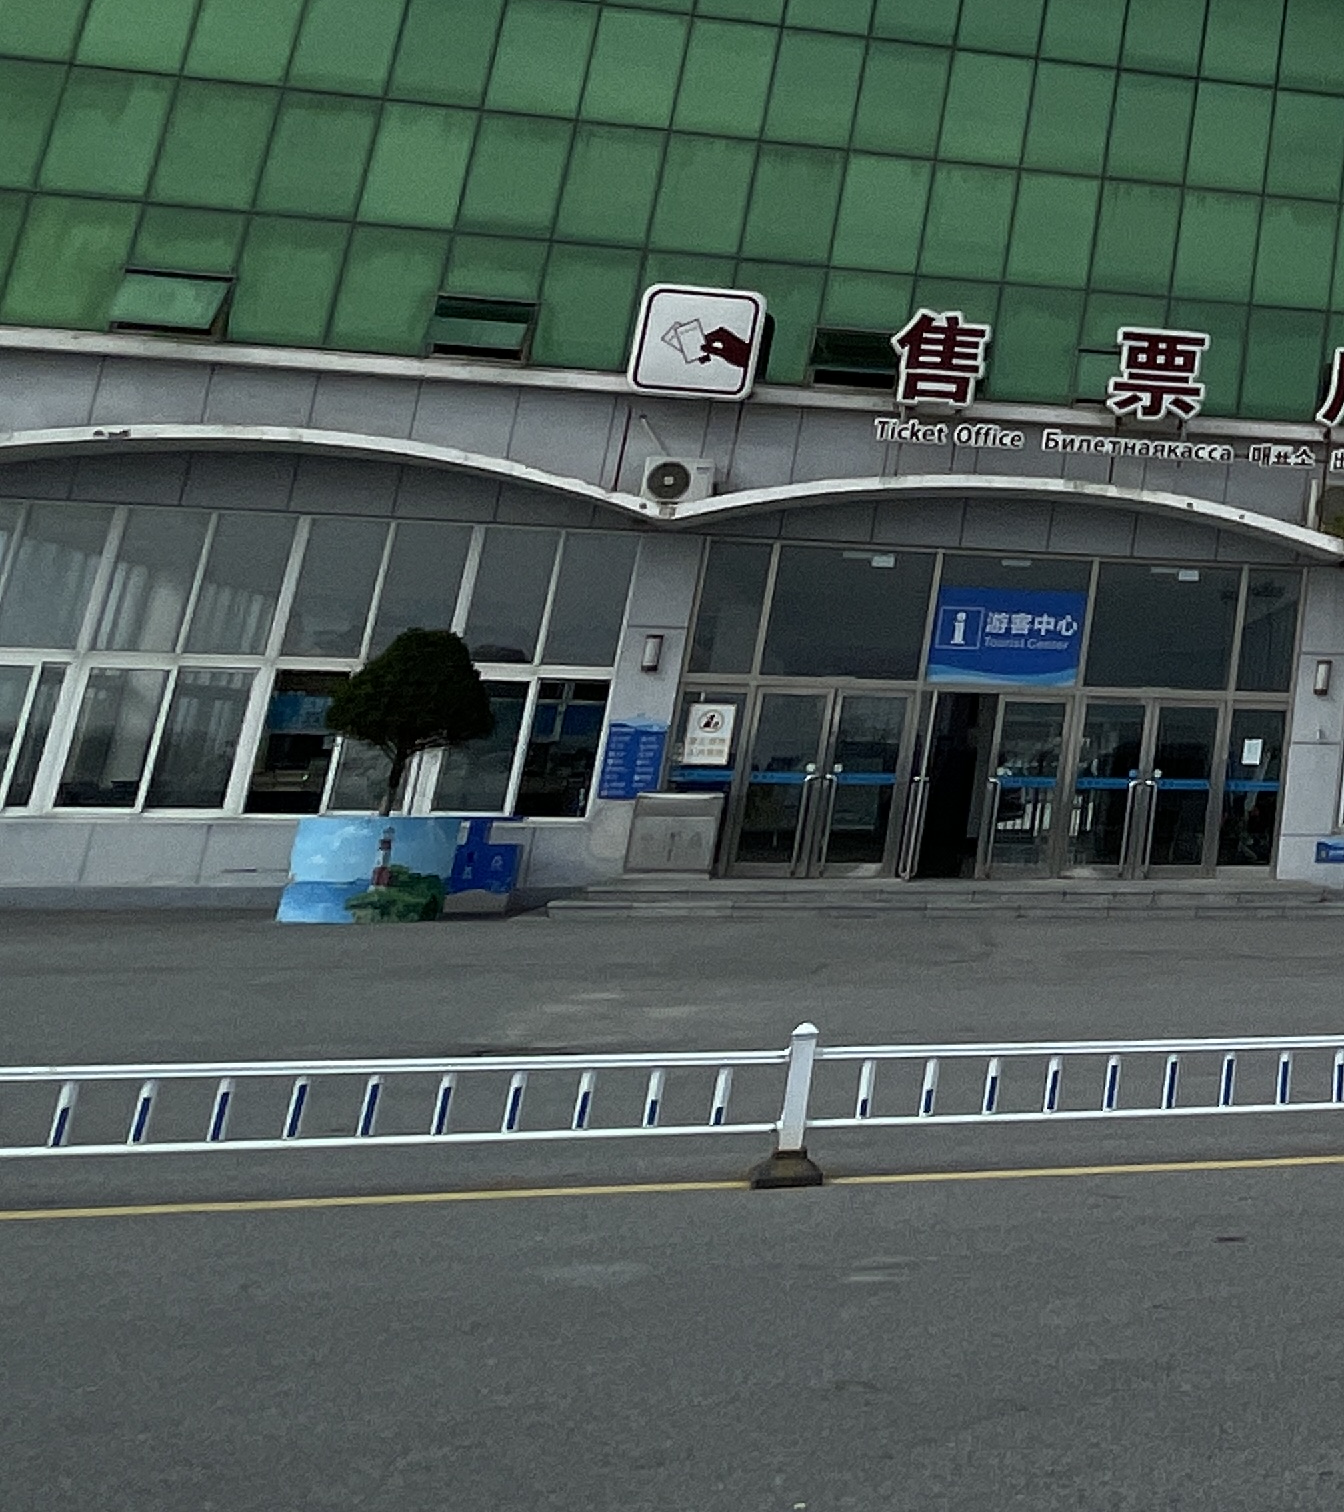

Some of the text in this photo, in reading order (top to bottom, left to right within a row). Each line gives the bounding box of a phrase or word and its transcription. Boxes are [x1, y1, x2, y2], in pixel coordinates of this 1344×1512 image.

[874, 418, 1024, 449] Ticket Office
[1041, 429, 1236, 463] Билетнаякасса
[1248, 443, 1316, 468] 매표소
[985, 612, 1078, 635] 游客中心
[984, 636, 1070, 650] Tourist Center
